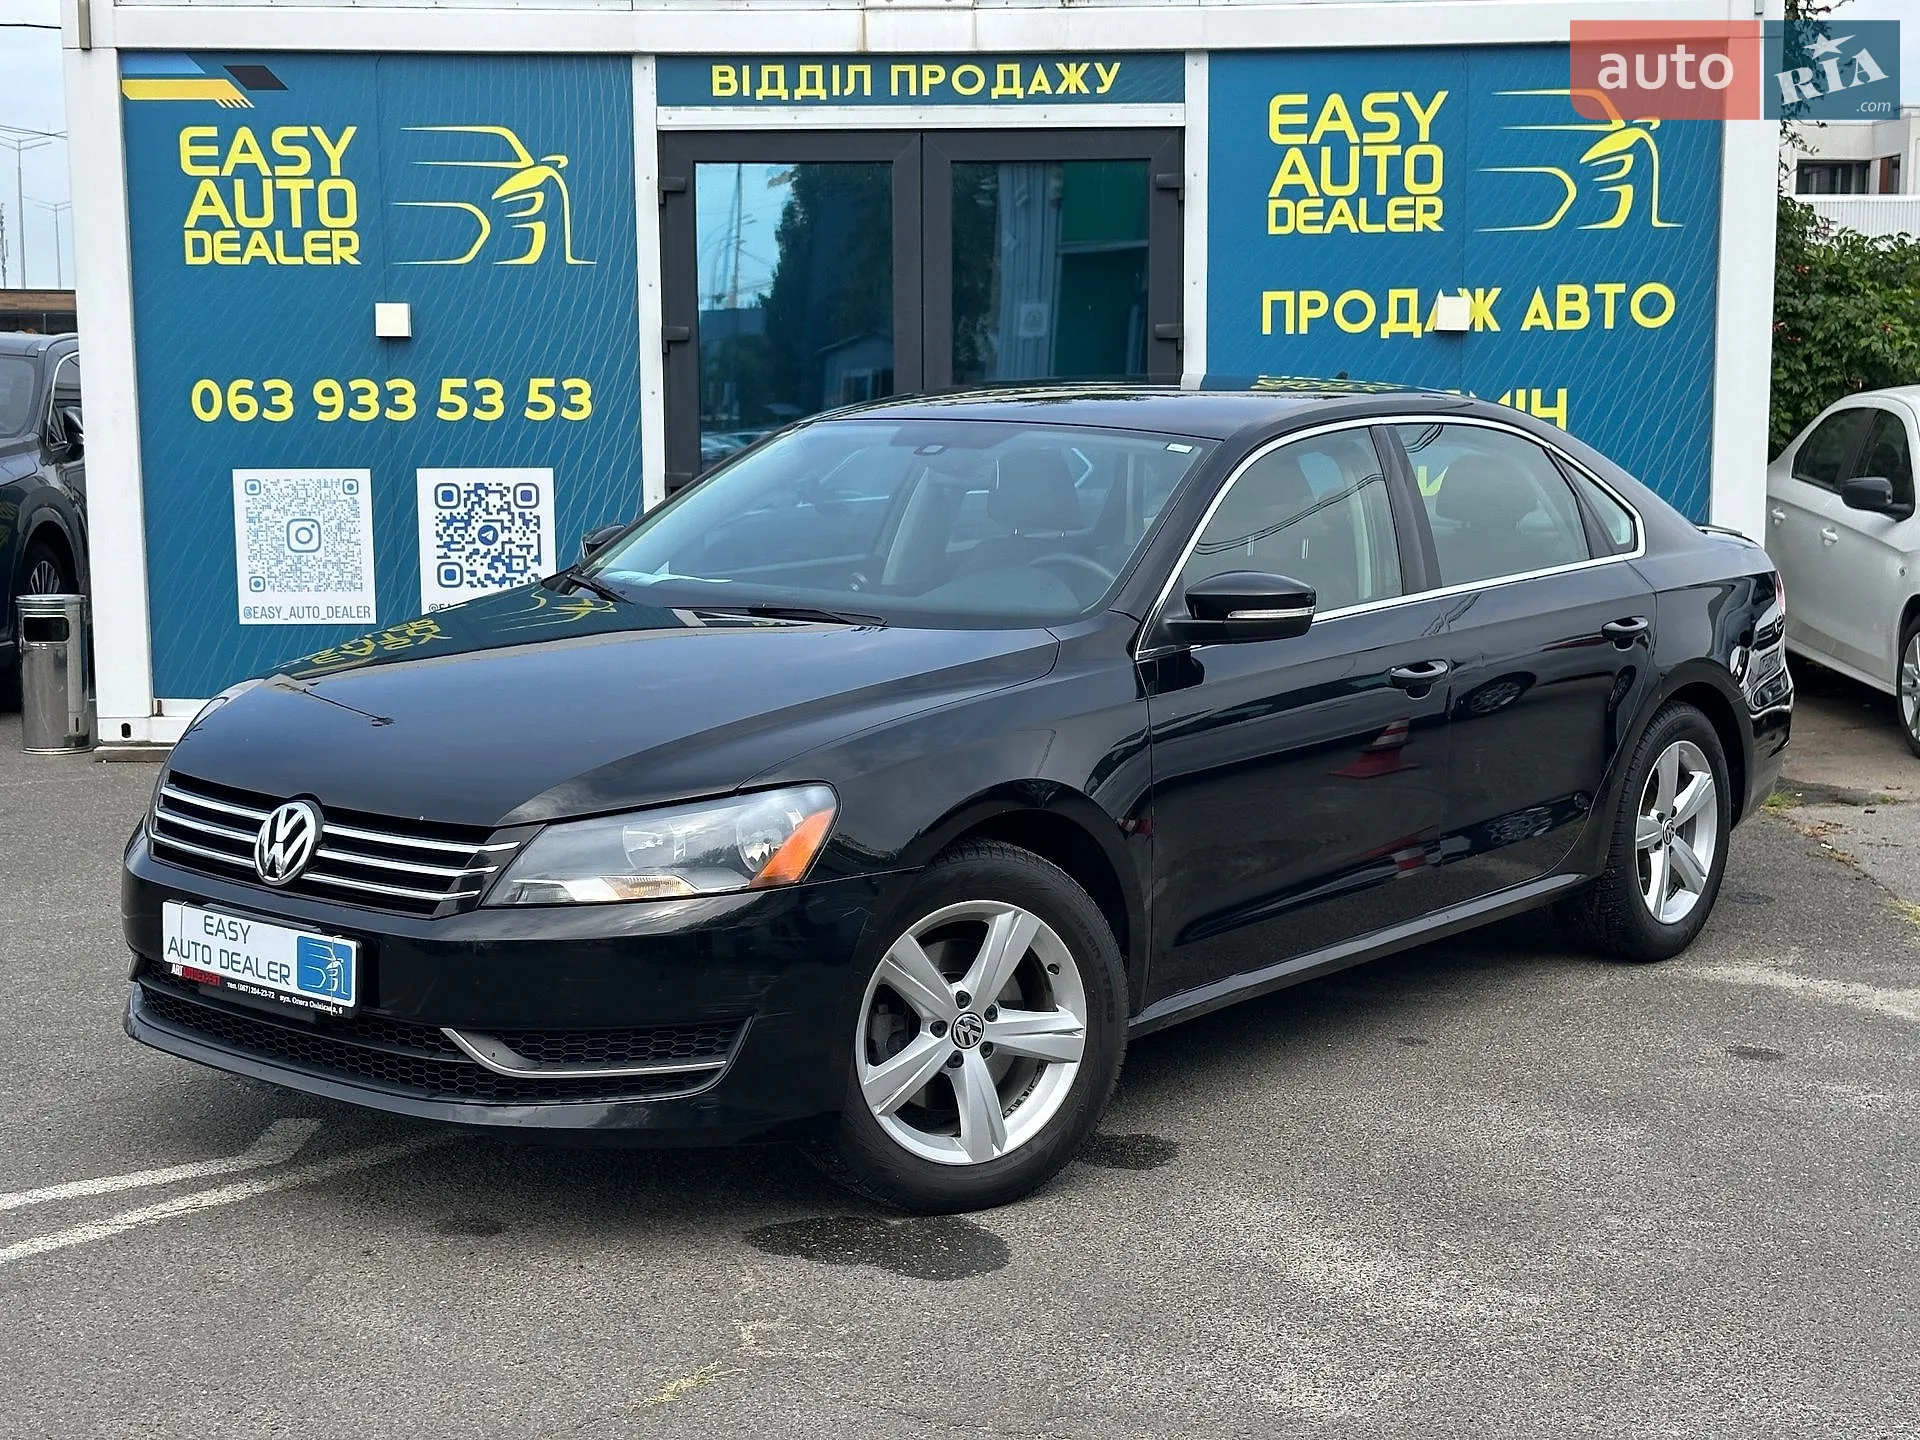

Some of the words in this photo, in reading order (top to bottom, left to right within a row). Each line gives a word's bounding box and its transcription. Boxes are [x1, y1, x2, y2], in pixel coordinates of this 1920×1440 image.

[712, 64, 871, 101] ВІДДІЛ
[891, 62, 1121, 99] ПРОДАЖУ
[1268, 91, 1448, 144] EASY
[179, 126, 357, 176] EASY
[1268, 144, 1444, 198] AUTO
[184, 179, 358, 229] AUTO
[1267, 197, 1445, 235] DEALER
[184, 229, 361, 266] DEALER
[1521, 282, 1676, 332] АВТО
[191, 379, 295, 422] 063
[312, 379, 417, 422] 933
[437, 378, 505, 421] 53
[524, 378, 593, 421] 53
[243, 605, 371, 620] @EASY_AUTO_DEALER
[203, 914, 251, 944] EASY
[167, 936, 212, 965] AUTO
[219, 948, 291, 985] DEALER
